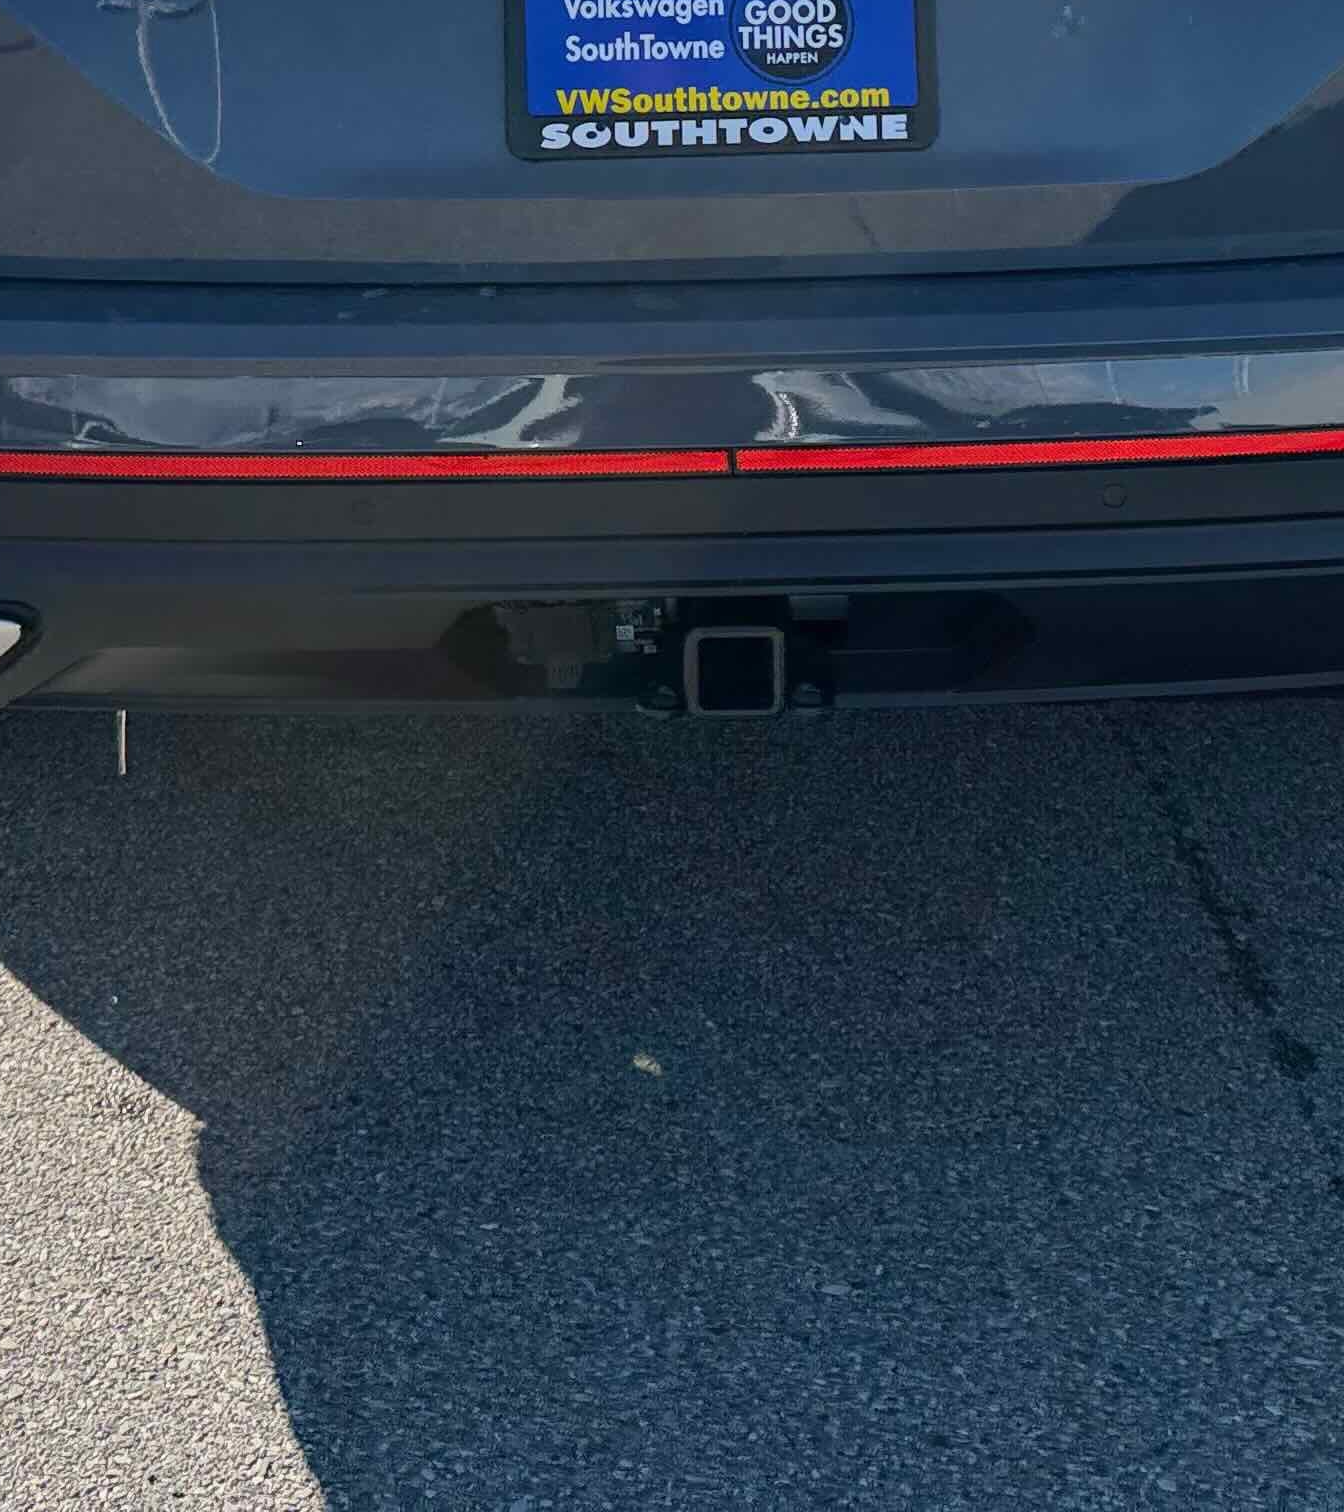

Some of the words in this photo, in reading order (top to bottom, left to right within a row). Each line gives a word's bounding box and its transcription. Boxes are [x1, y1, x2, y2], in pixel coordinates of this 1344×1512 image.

[744, 0, 837, 25] GOOD
[565, 32, 725, 62] SouthTowne
[738, 24, 844, 51] THINGS
[766, 51, 819, 65] HAPPEN
[556, 86, 890, 115] VWSouthtowne.com
[540, 114, 909, 150] SOUTHTOWNE
